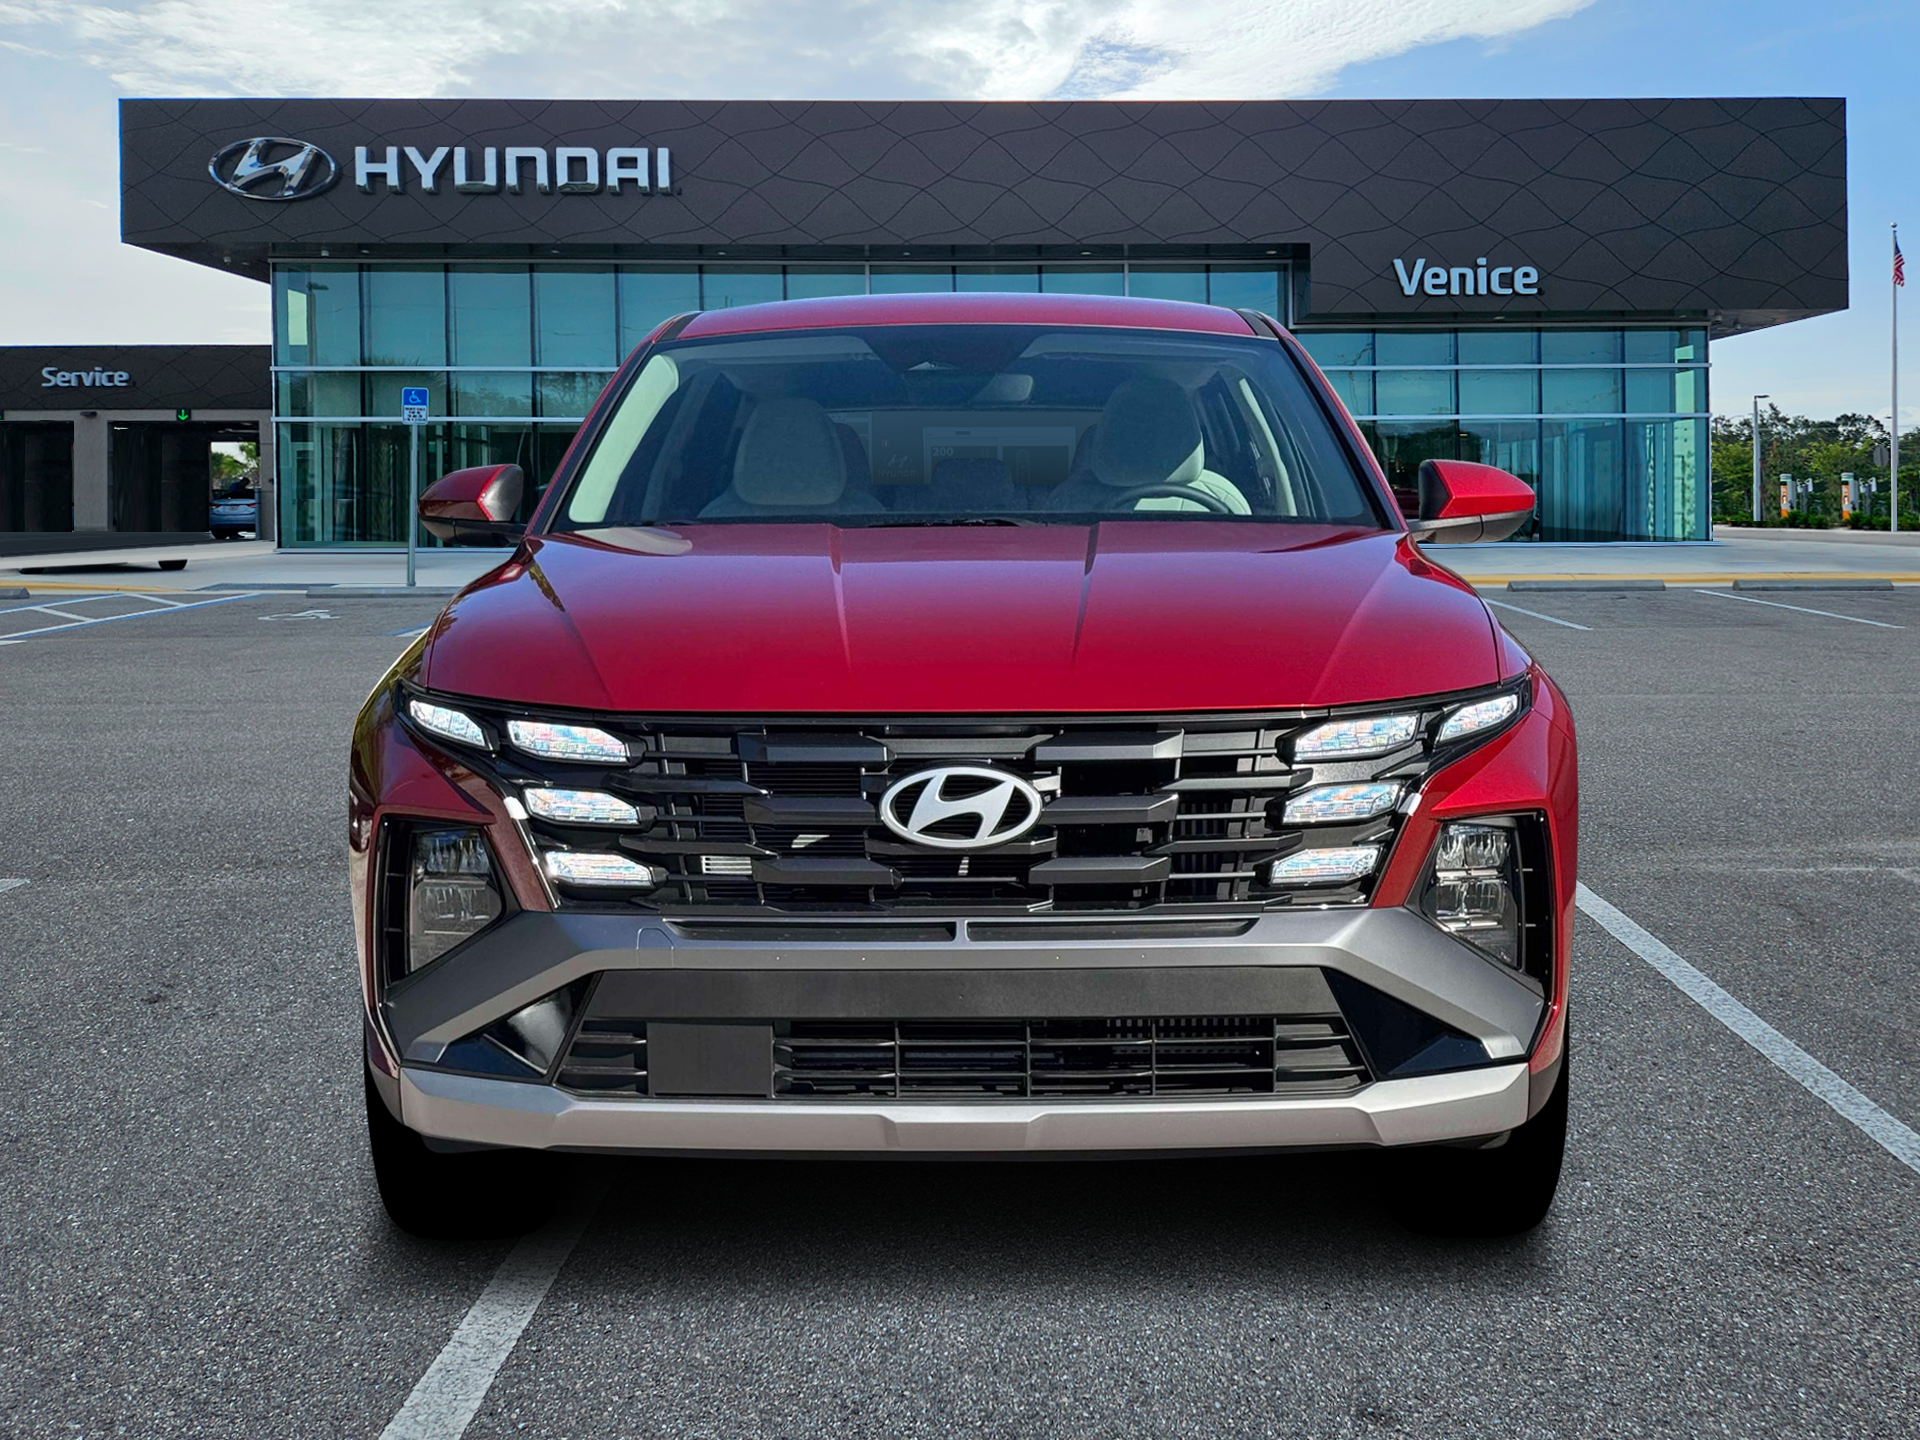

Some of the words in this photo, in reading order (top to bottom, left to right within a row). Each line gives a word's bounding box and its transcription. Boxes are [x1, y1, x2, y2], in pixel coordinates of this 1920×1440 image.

[354, 146, 672, 194] HYUNDAI
[1392, 256, 1539, 296] Venice
[41, 366, 130, 387] Service
[933, 446, 954, 456] 200
[878, 470, 919, 478] HYUNDAI
